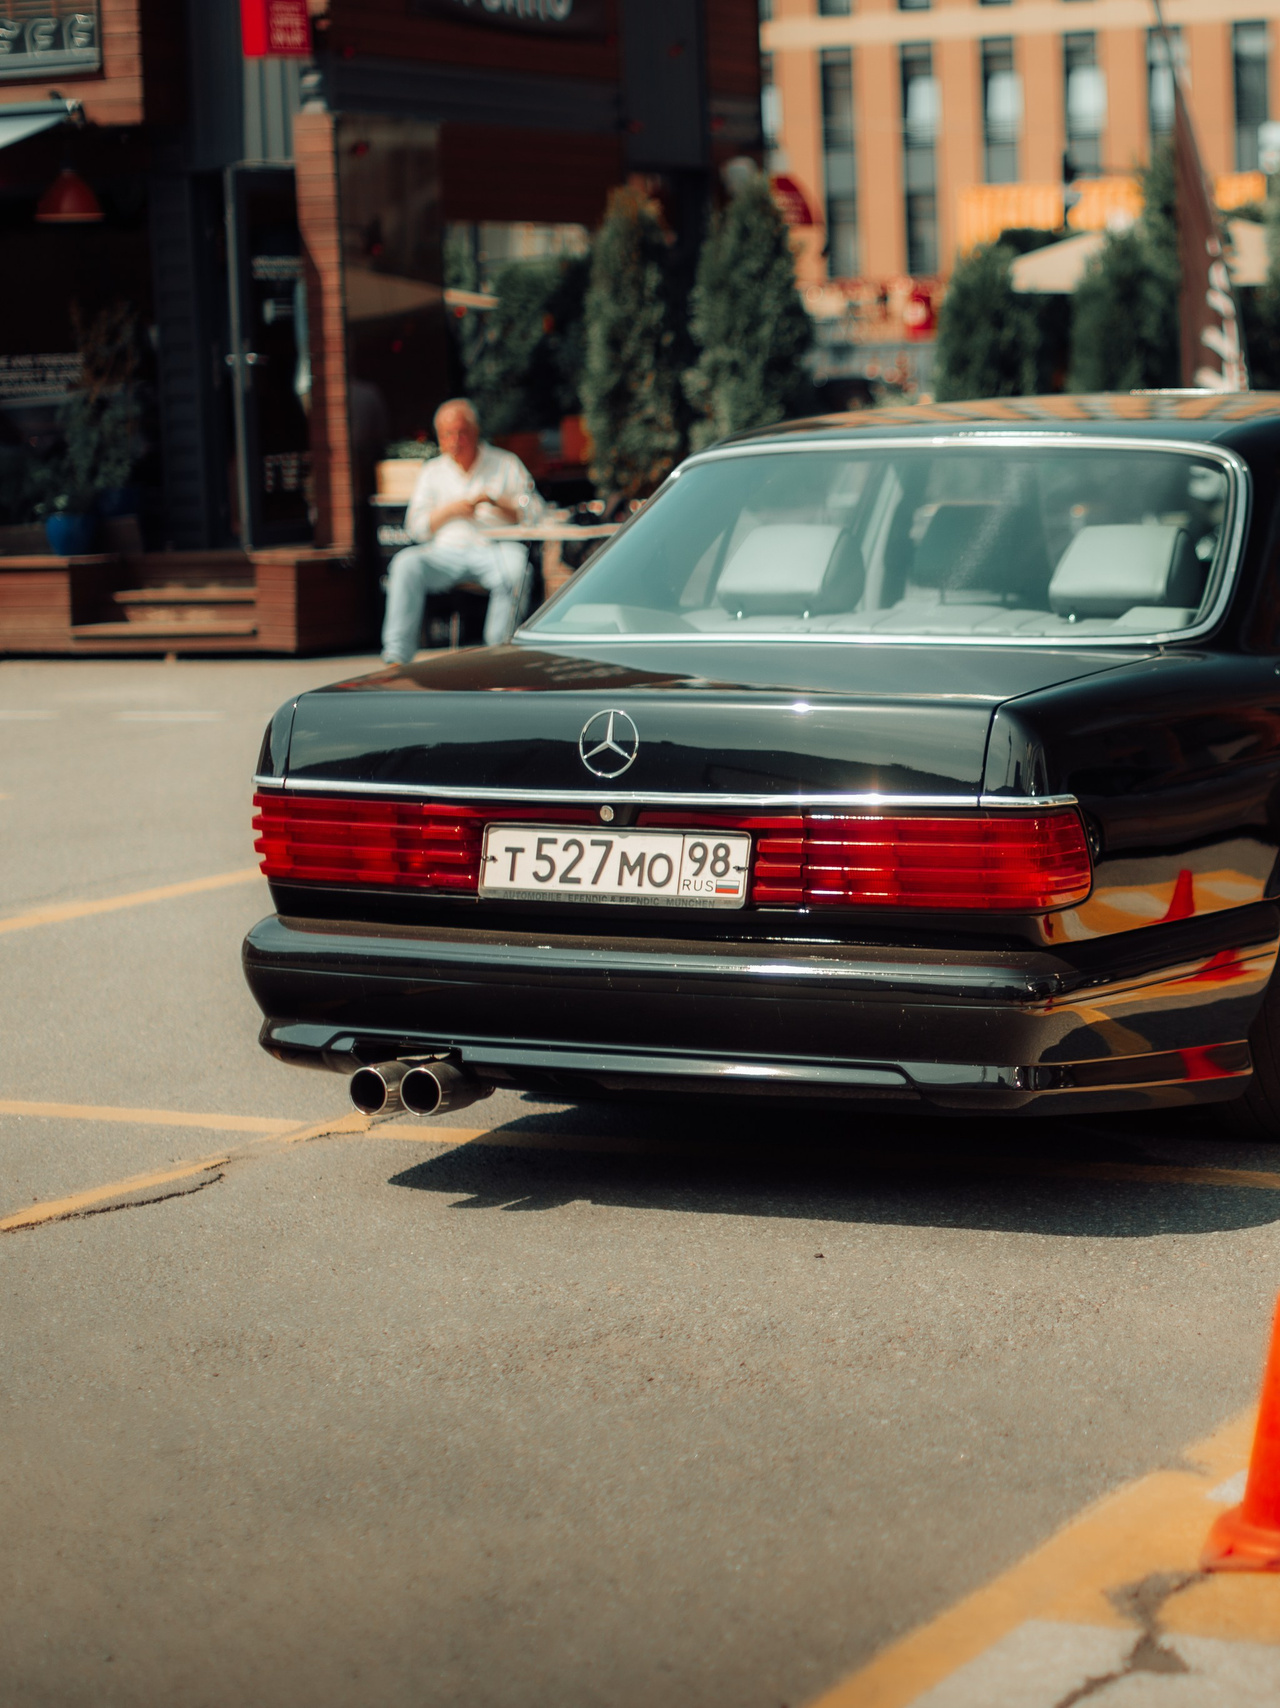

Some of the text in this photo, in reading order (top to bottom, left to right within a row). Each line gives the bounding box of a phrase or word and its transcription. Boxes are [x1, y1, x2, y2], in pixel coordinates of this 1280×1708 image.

[688, 841, 731, 878] 98
[682, 879, 714, 892] RUS
[503, 891, 562, 901] AUTOMOBILE
